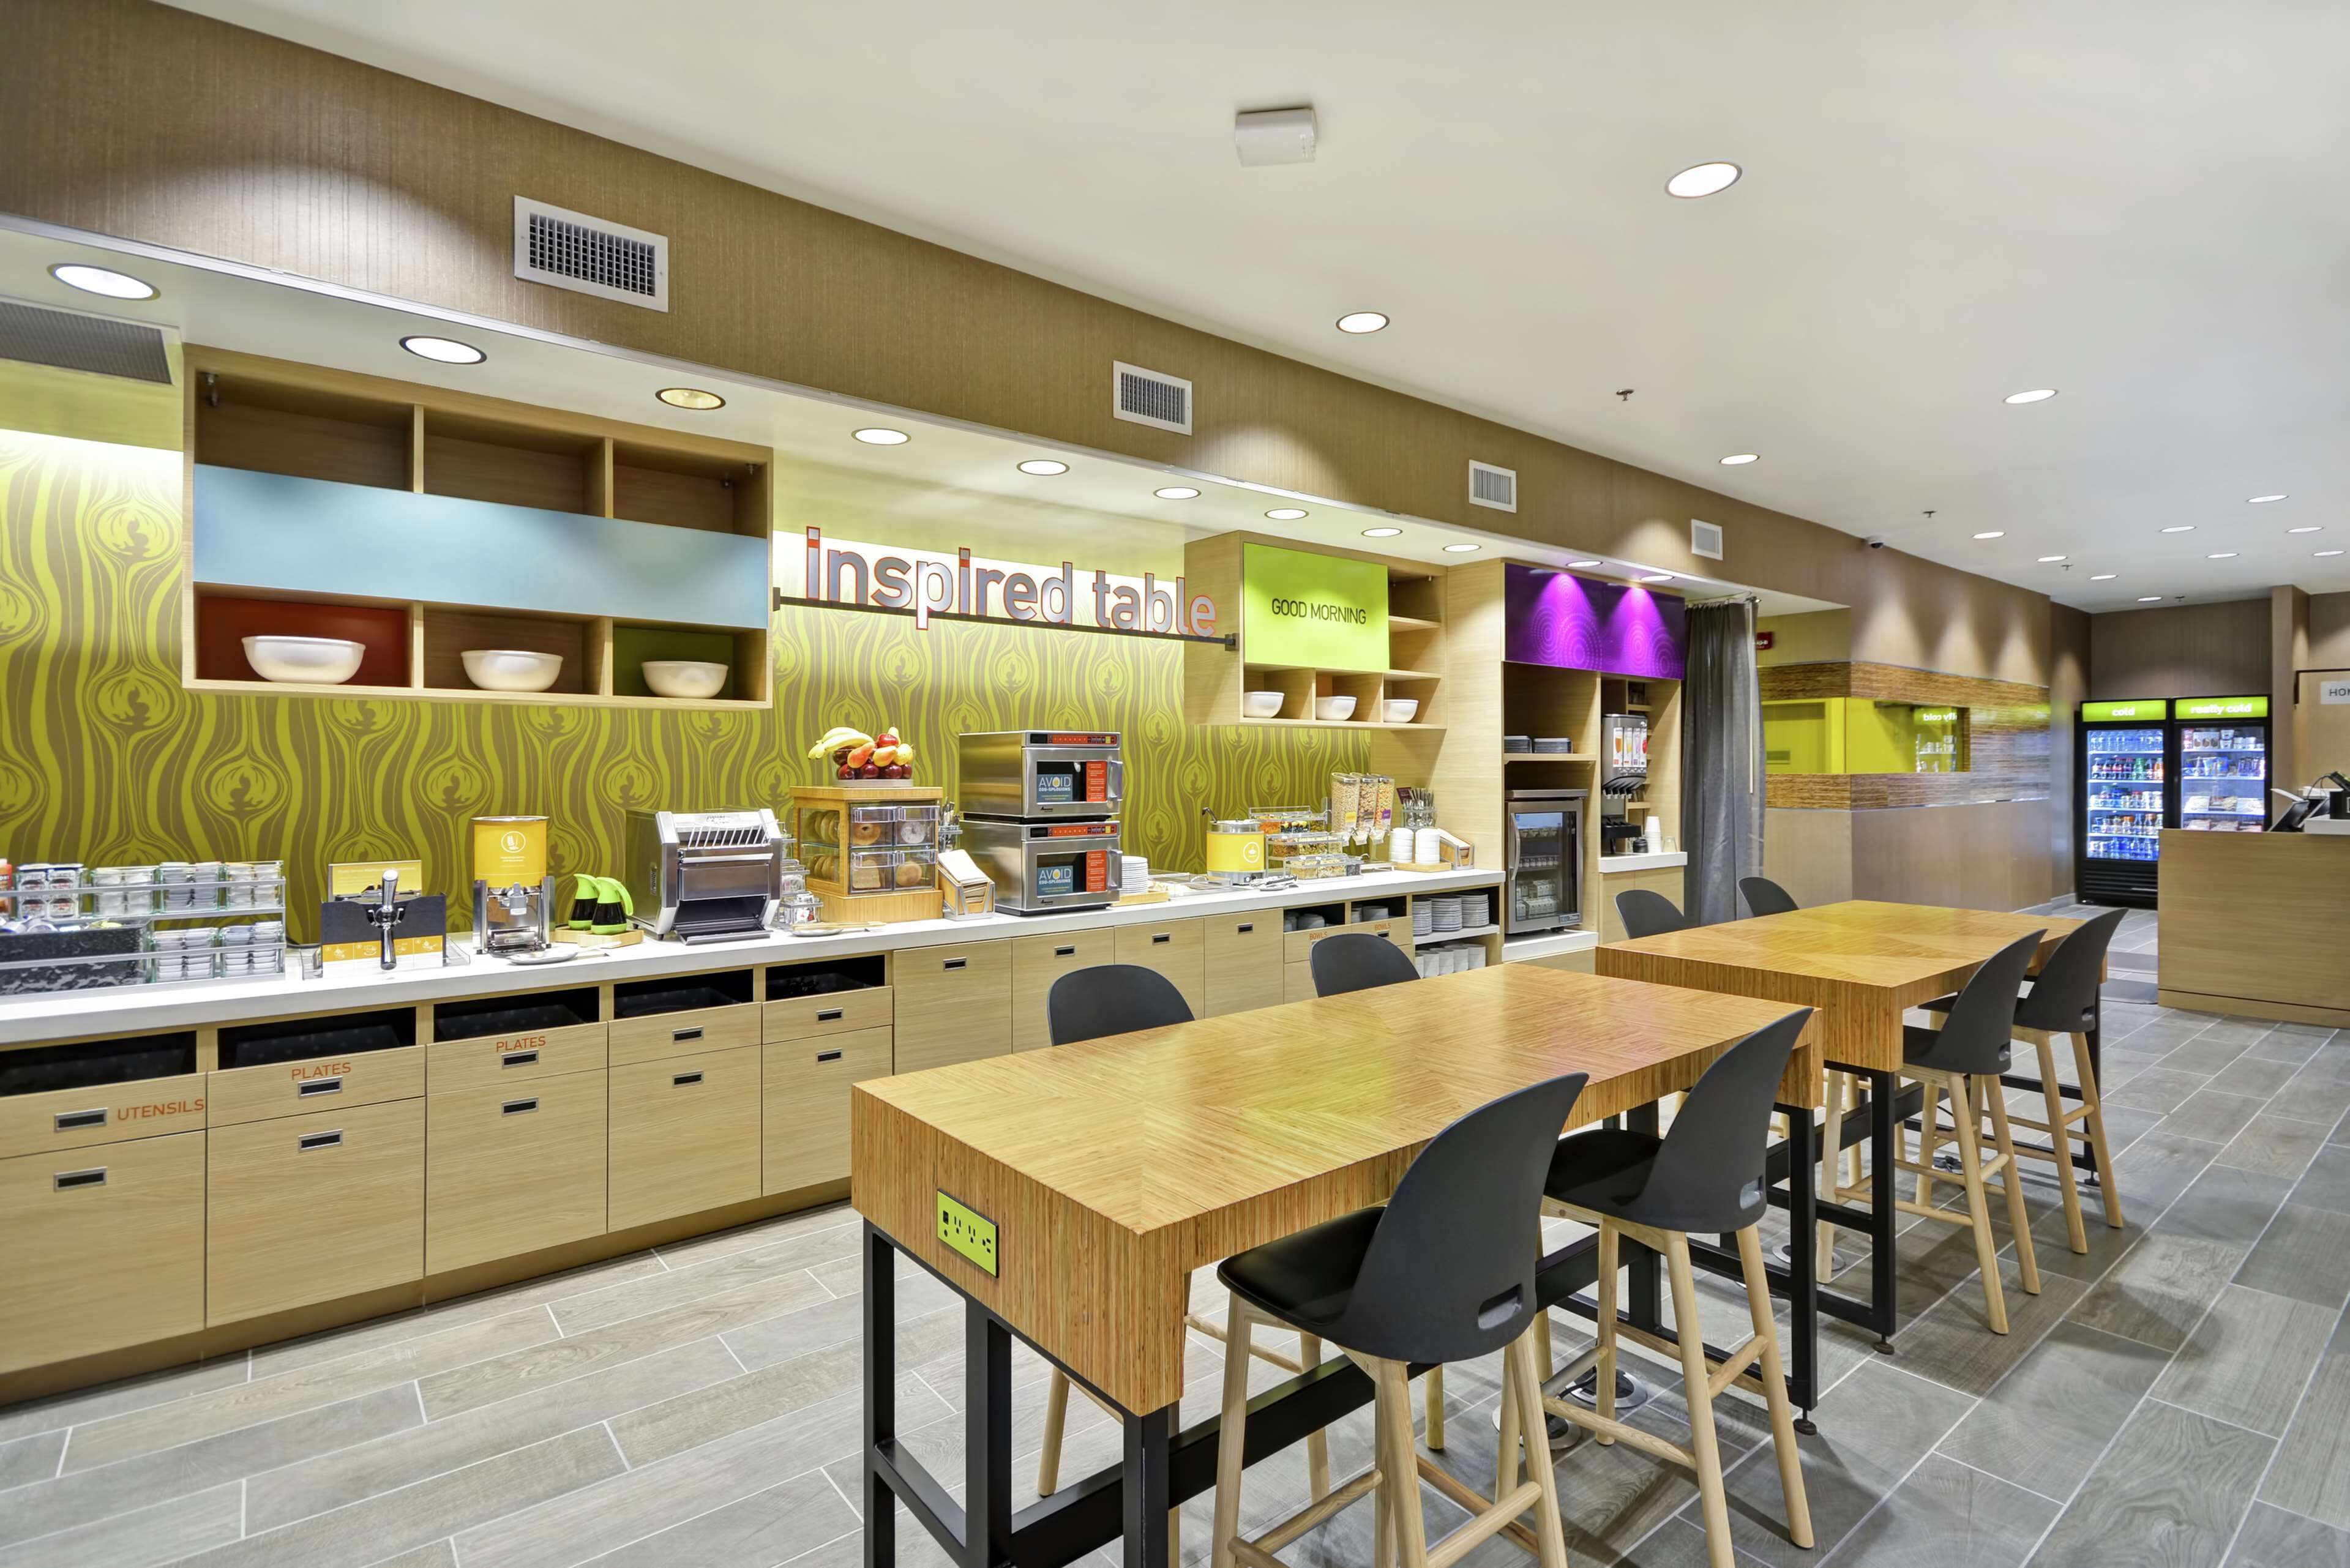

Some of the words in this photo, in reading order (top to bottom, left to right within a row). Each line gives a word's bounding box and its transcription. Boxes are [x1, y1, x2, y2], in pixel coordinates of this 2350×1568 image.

[806, 526, 1073, 631] inspired
[1092, 569, 1217, 638] table
[1271, 598, 1308, 618] GOOD
[1311, 602, 1367, 625] MORNING
[2111, 707, 2135, 717] cold
[2190, 704, 2224, 715] really
[2225, 703, 2252, 714] cold
[1038, 776, 1071, 788] AVOID
[1039, 868, 1071, 880] AVOID
[1374, 922, 1391, 931] BOWLS
[1309, 931, 1328, 941] BOWLS
[496, 1036, 547, 1053] PLATES
[291, 1062, 351, 1080] PLATES
[118, 1099, 204, 1121] UTENSILS
